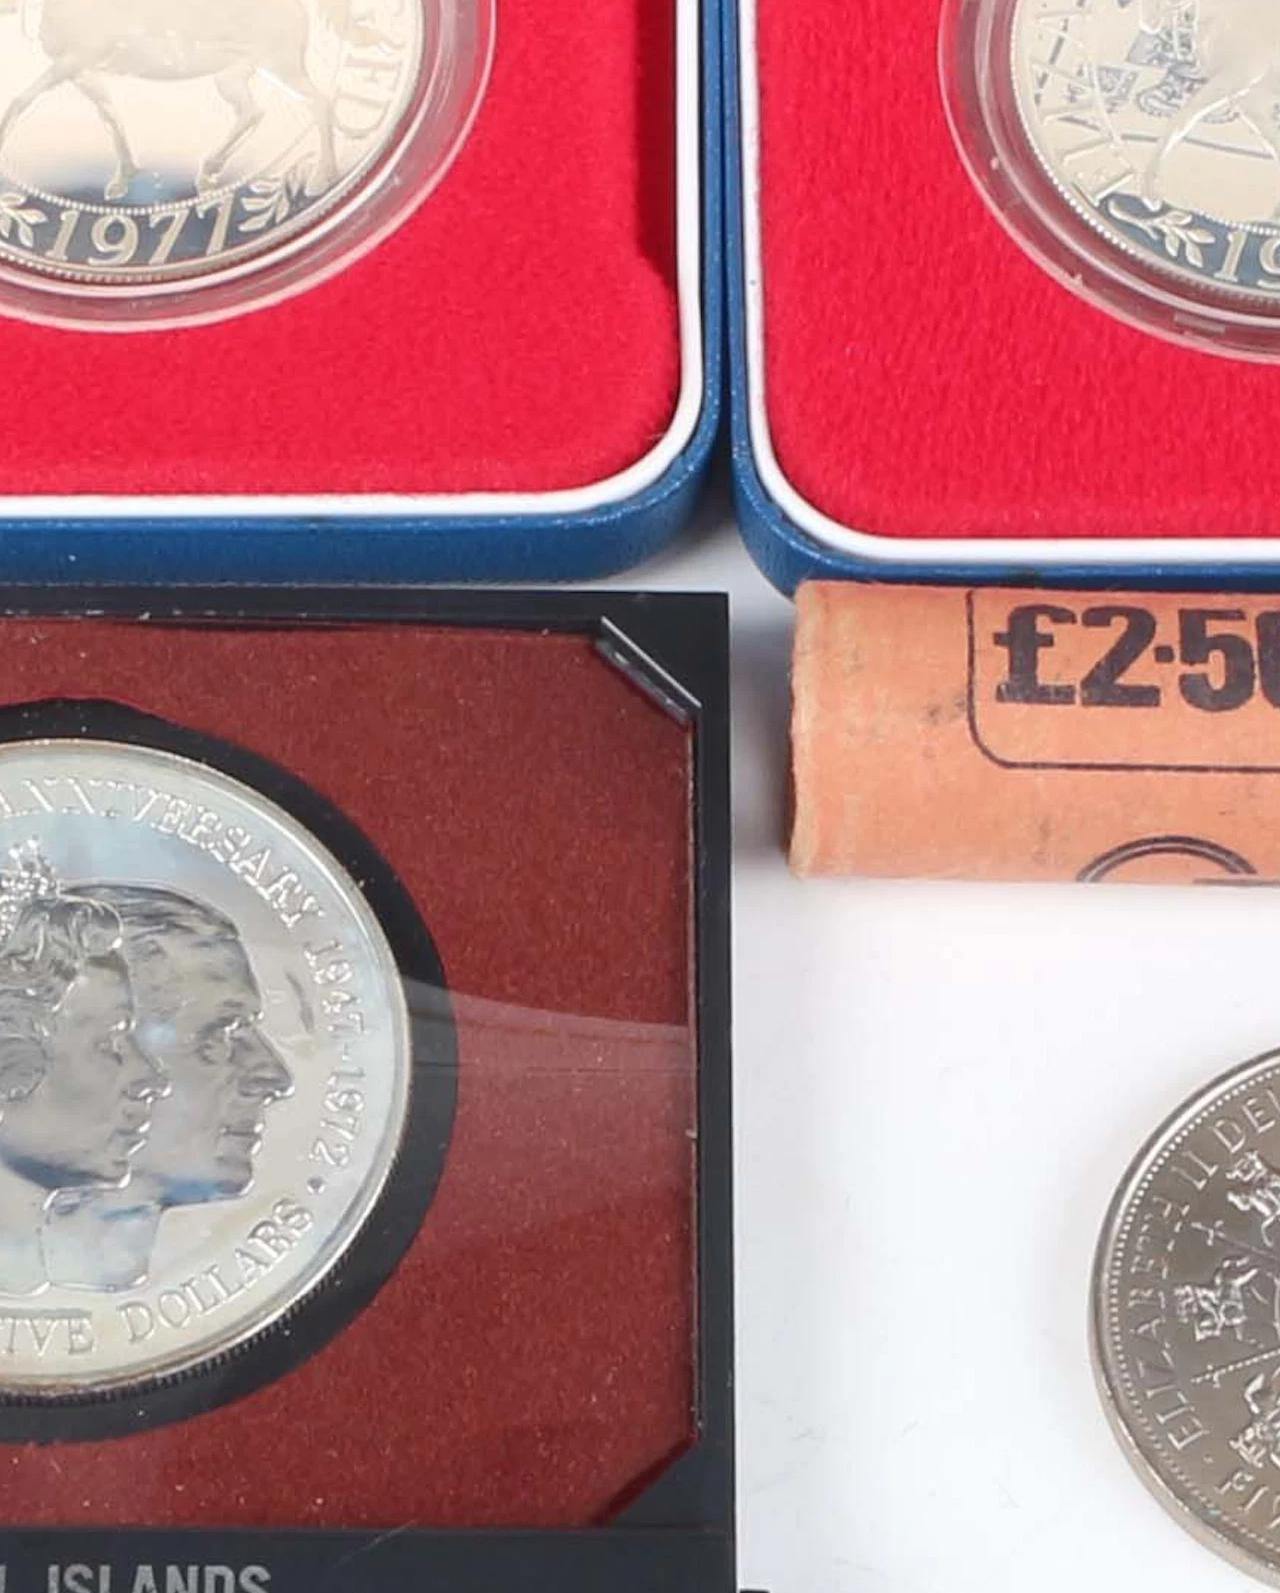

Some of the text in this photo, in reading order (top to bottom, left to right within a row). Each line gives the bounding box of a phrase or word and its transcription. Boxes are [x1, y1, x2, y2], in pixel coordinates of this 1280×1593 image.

[46, 197, 238, 267] 1977
[116, 1191, 317, 1345] DOLLARS
[1127, 1191, 1211, 1452] ELIZABETH
